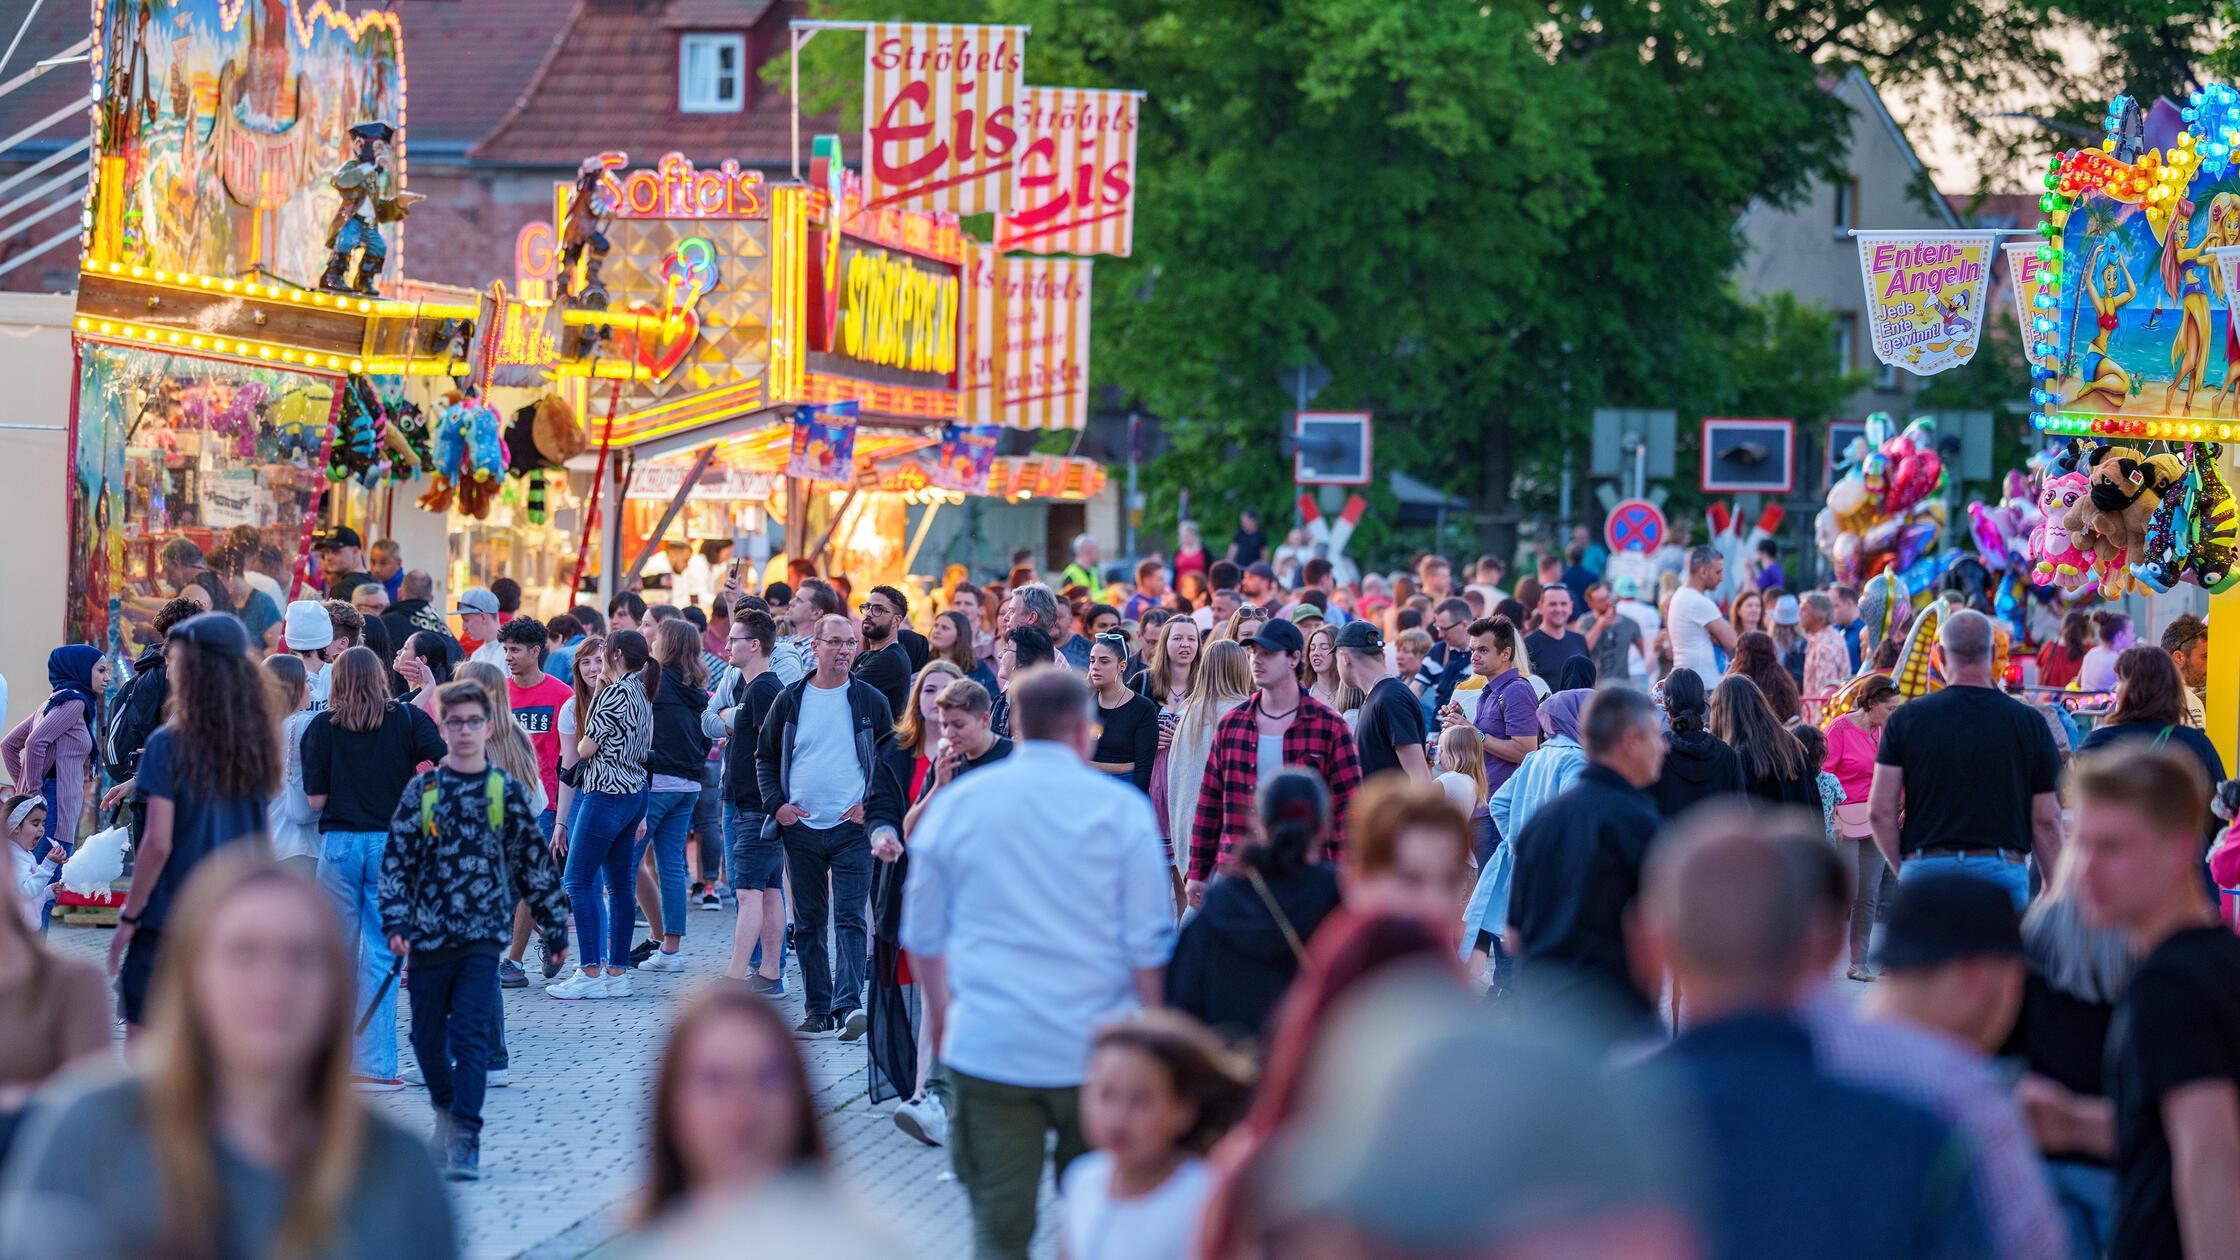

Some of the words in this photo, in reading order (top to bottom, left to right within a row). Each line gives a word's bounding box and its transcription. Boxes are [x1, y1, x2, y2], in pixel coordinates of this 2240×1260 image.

[871, 39, 1020, 73] Ströbels
[869, 80, 1017, 186] Eis
[601, 156, 761, 214] Softeis
[1007, 137, 1130, 227] Eis
[1872, 241, 1963, 274] Enten-
[1884, 259, 1980, 299] Angeln
[1878, 301, 1915, 321] Jede
[1880, 320, 1913, 338] Ente
[1880, 323, 1940, 356] gewinnt!
[409, 614, 453, 638] adida
[519, 721, 548, 731] NES
